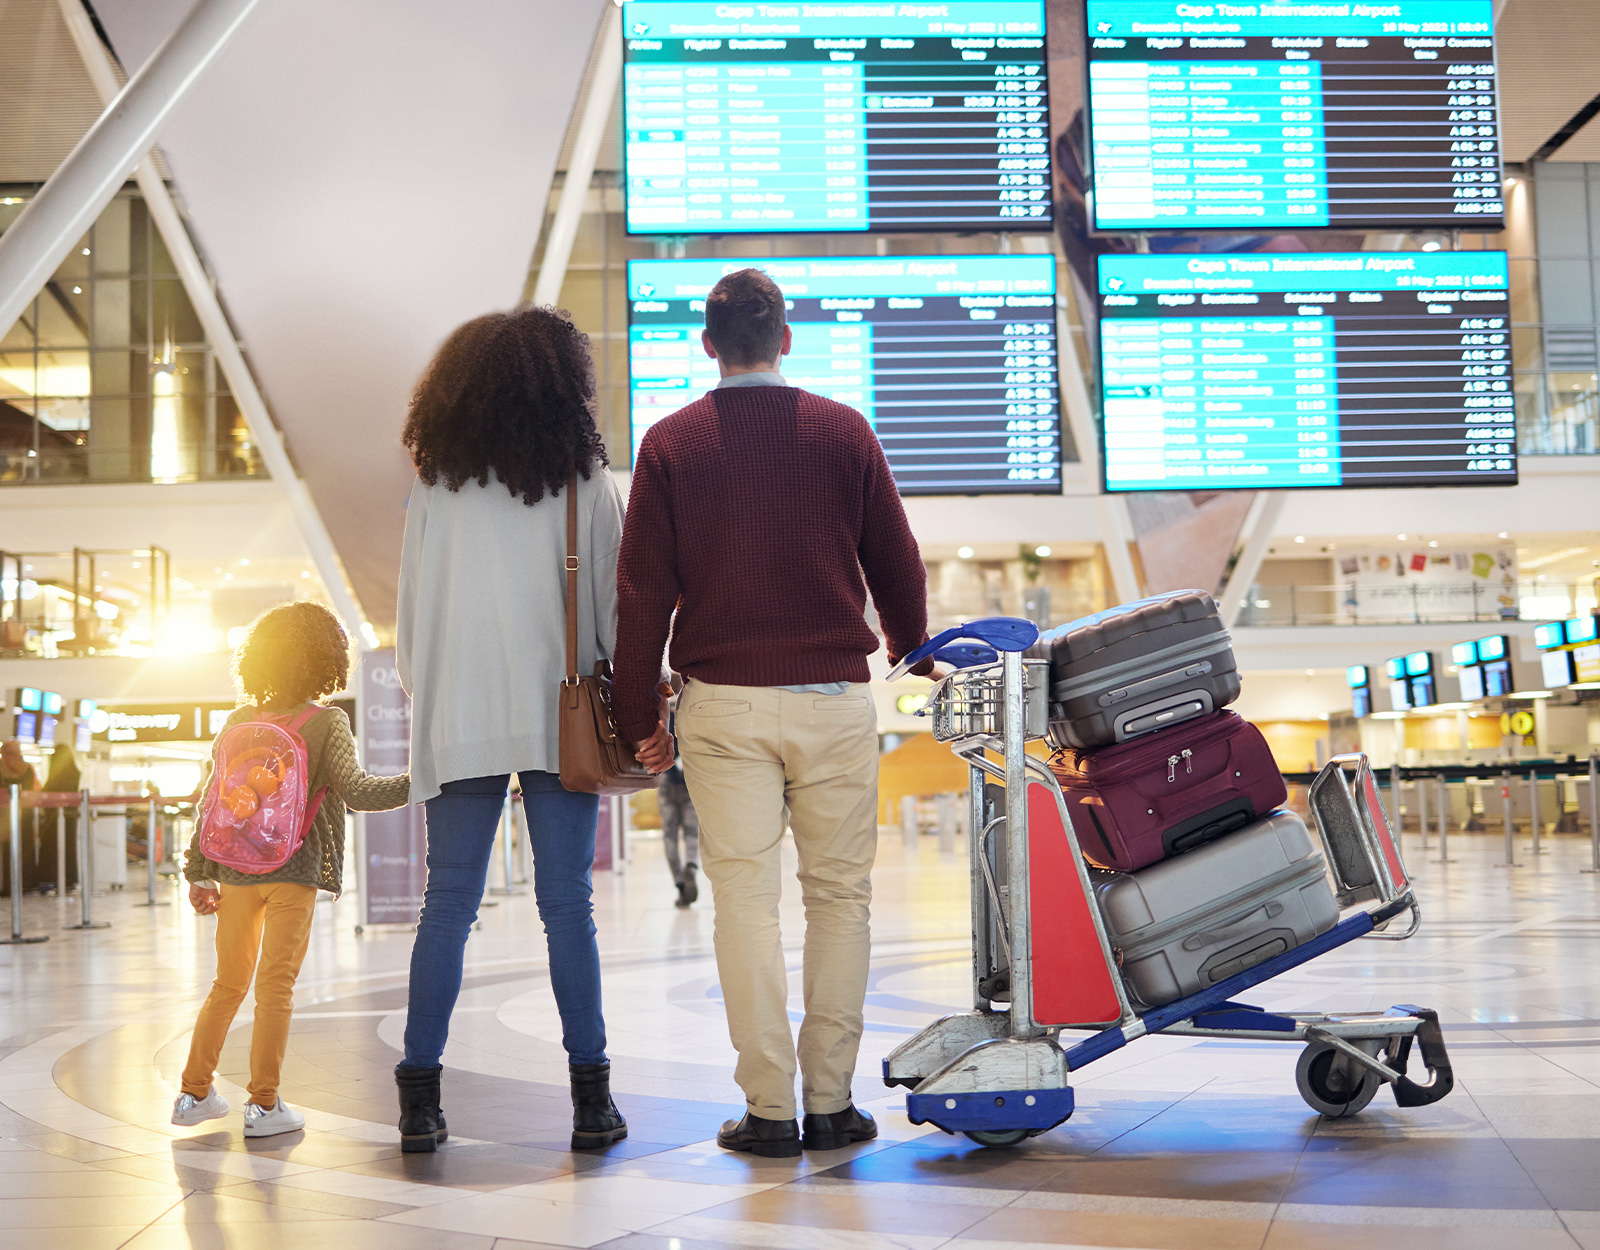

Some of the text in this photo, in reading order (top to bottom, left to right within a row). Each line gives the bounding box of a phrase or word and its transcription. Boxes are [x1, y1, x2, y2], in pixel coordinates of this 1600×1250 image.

[716, 5, 949, 20] Cape Town International Airport
[1176, 4, 1402, 18] Cape Town International Airport
[670, 24, 801, 35] International Departures
[943, 22, 967, 34] May
[968, 22, 997, 33] 2022
[1132, 23, 1241, 34] Domestic Departures
[1398, 22, 1421, 34] May
[1421, 22, 1448, 32] 2022
[629, 40, 662, 50] Airline
[729, 40, 787, 50] Destination
[814, 39, 866, 49] Scheduled
[881, 39, 914, 49] Status
[951, 38, 994, 49] Updated
[996, 38, 1044, 48] Counters
[1093, 38, 1126, 48] Airline
[1190, 38, 1246, 48] Destination
[1272, 37, 1322, 48] Scheduled
[1336, 37, 1369, 48] Status
[1404, 37, 1446, 49] Updated
[1447, 37, 1492, 47] Counters
[809, 263, 904, 276] International
[906, 262, 958, 277] Airport
[1188, 258, 1415, 274] Cape Town International Airport
[1143, 278, 1254, 290] Domestic Departures
[1411, 275, 1434, 287] May
[1435, 275, 1463, 286] 2022
[821, 298, 875, 309] Scheduled
[960, 297, 1004, 308] Updated
[1104, 295, 1137, 306] Airline
[1202, 294, 1258, 304] Destination
[1285, 293, 1335, 303] Scheduled
[1349, 292, 1382, 302] Status
[1417, 291, 1460, 303] Updated
[1461, 291, 1507, 301] Counters
[109, 712, 180, 730] Discovery
